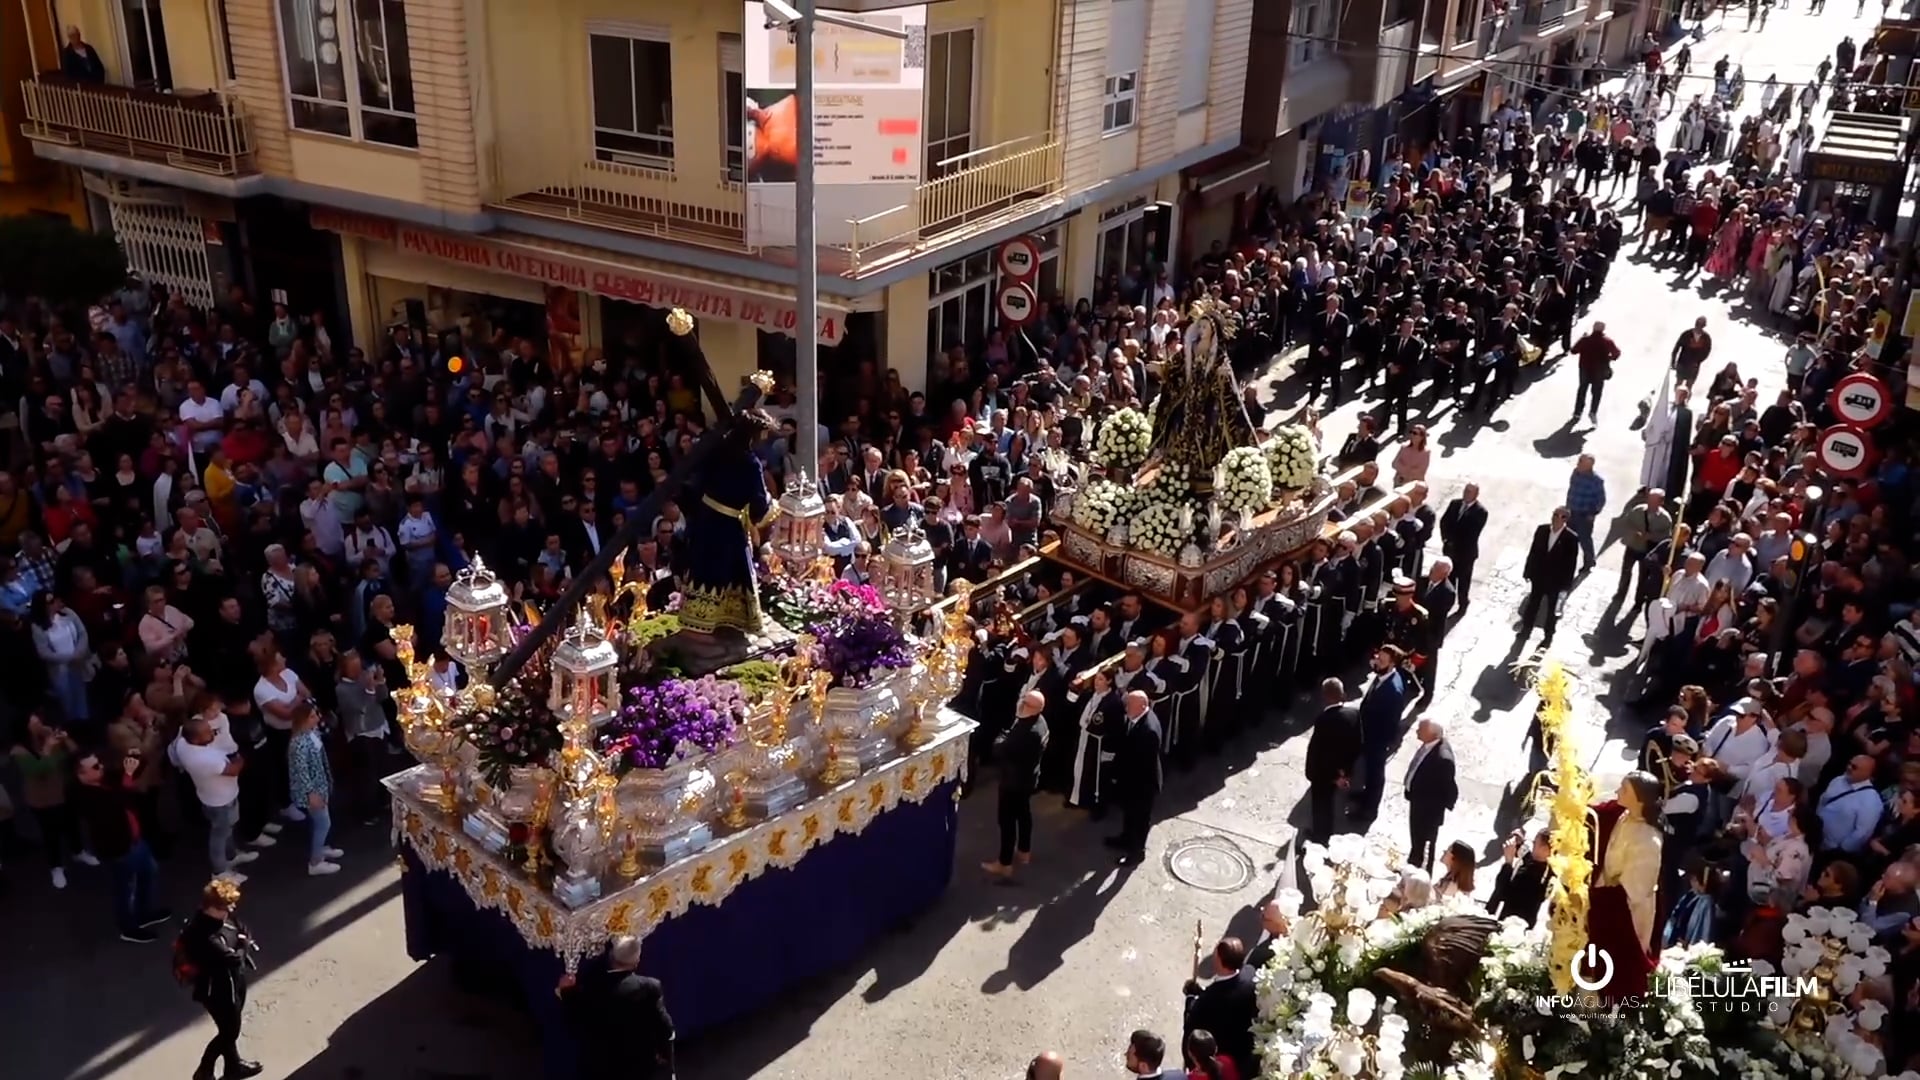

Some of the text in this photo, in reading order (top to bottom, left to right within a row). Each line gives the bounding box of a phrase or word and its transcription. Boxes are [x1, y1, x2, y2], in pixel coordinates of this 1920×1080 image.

[403, 231, 491, 266] PANADERIA
[496, 252, 587, 287] CAFETERIA
[657, 283, 732, 317] PUERTA
[740, 301, 766, 325] DE
[773, 308, 835, 340] LOA
